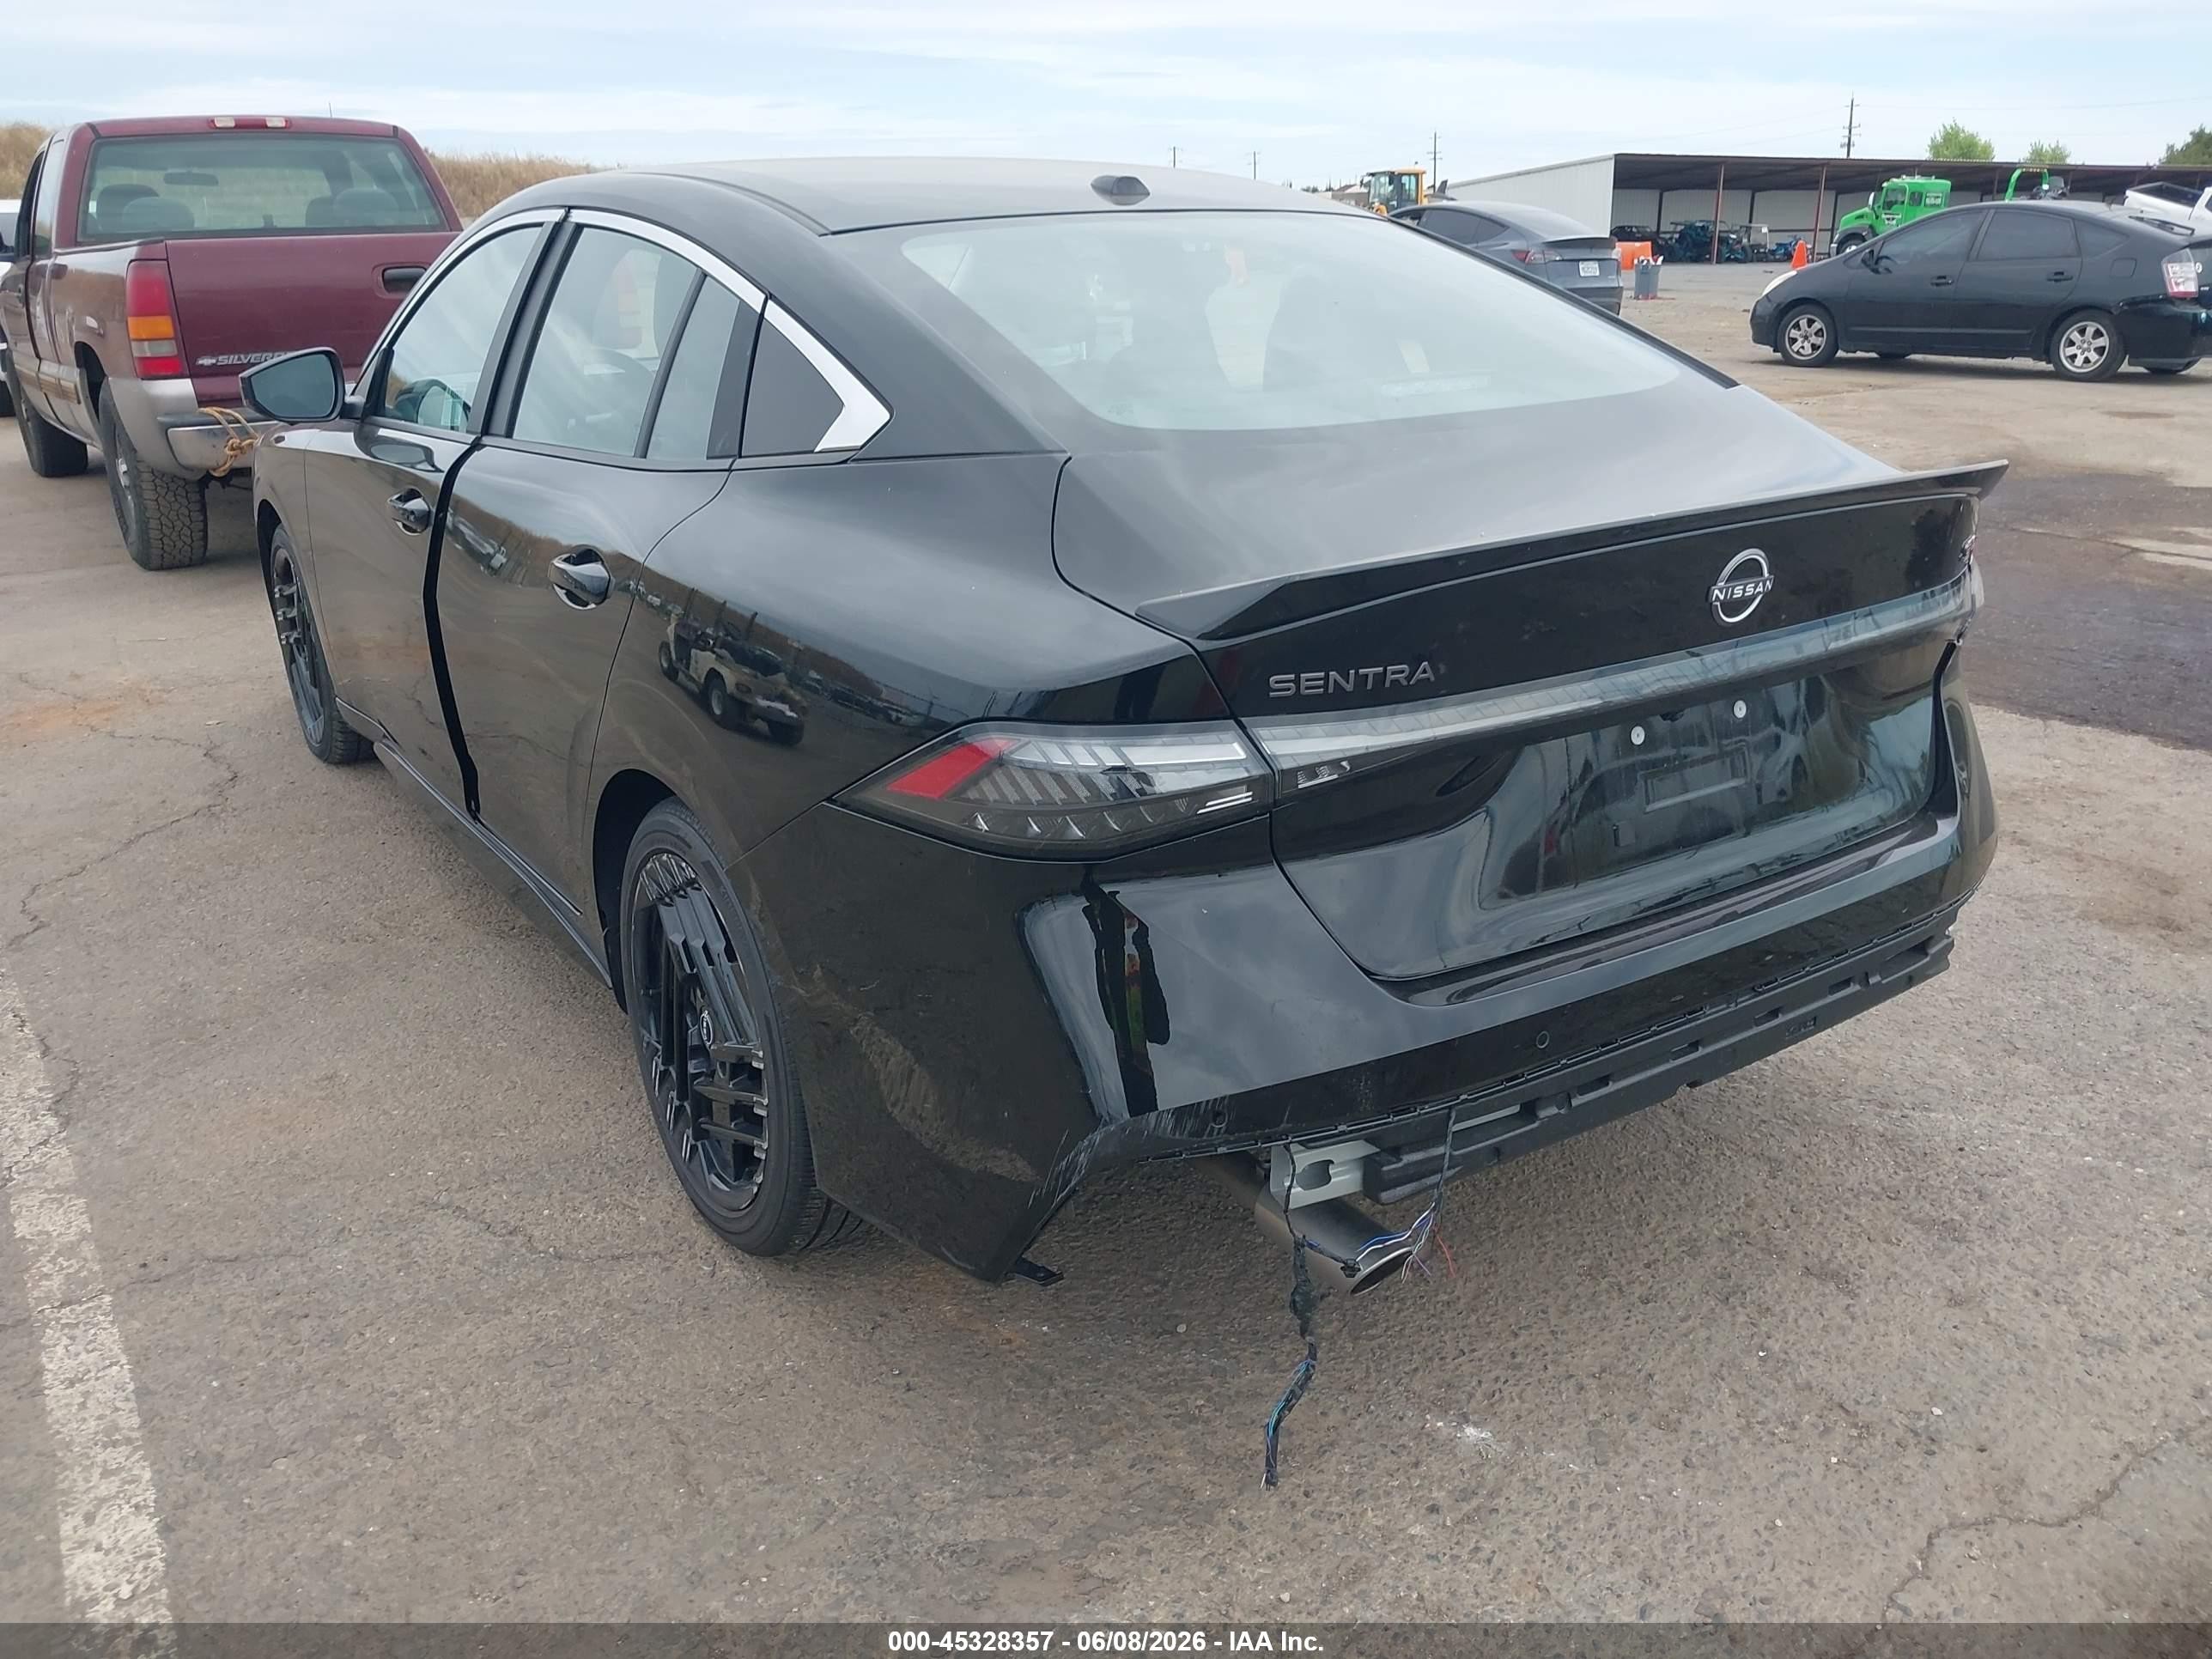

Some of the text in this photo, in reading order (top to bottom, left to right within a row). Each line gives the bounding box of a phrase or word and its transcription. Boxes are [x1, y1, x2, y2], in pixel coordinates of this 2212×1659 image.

[216, 351, 287, 365] SILVER
[1711, 580, 1772, 601] NISSAN
[1269, 660, 1435, 698] SENTRA
